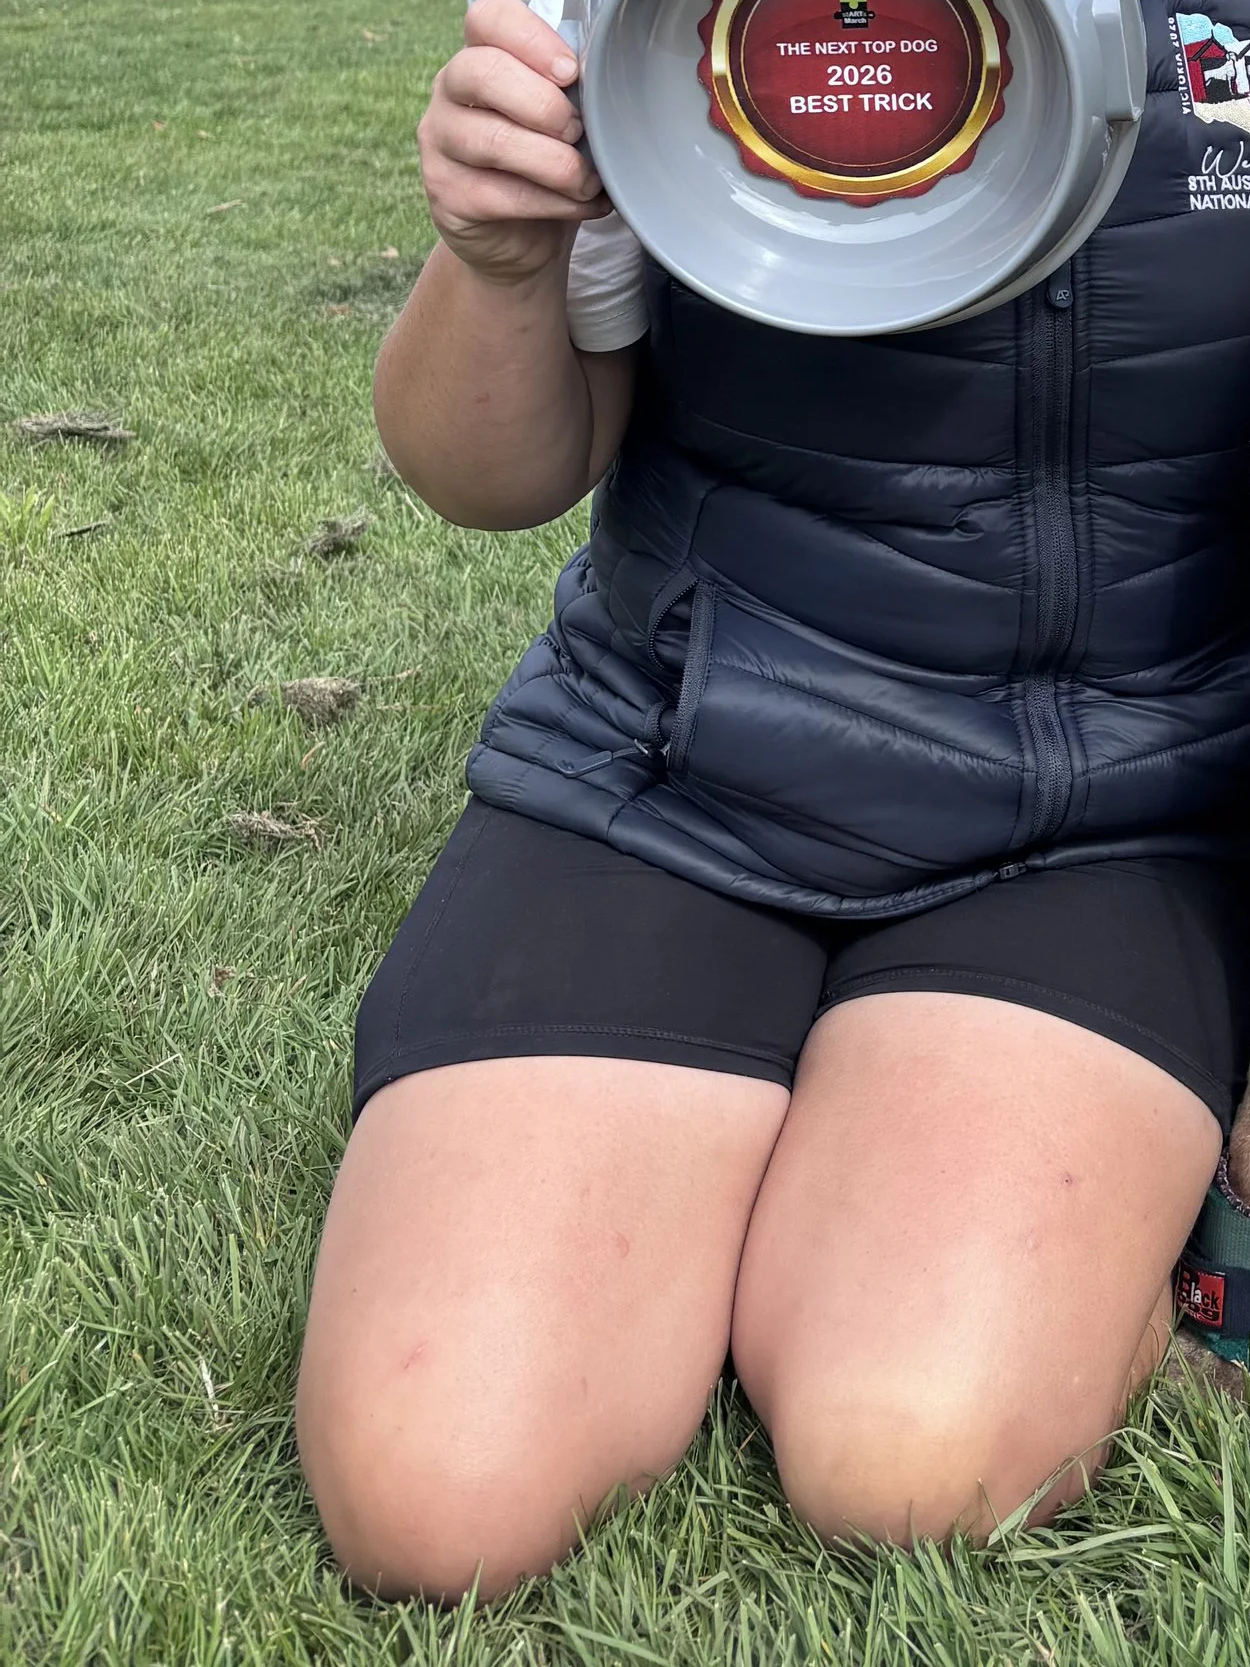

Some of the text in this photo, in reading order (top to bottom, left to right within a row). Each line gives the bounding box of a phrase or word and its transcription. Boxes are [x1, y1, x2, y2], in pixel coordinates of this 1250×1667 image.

[776, 39, 938, 56] THE NEXT TOP DOG
[826, 64, 893, 86] 2026
[1174, 53, 1192, 115] VICTORIA
[789, 92, 933, 114] BEST TRICK
[1187, 175, 1217, 191] 8TH
